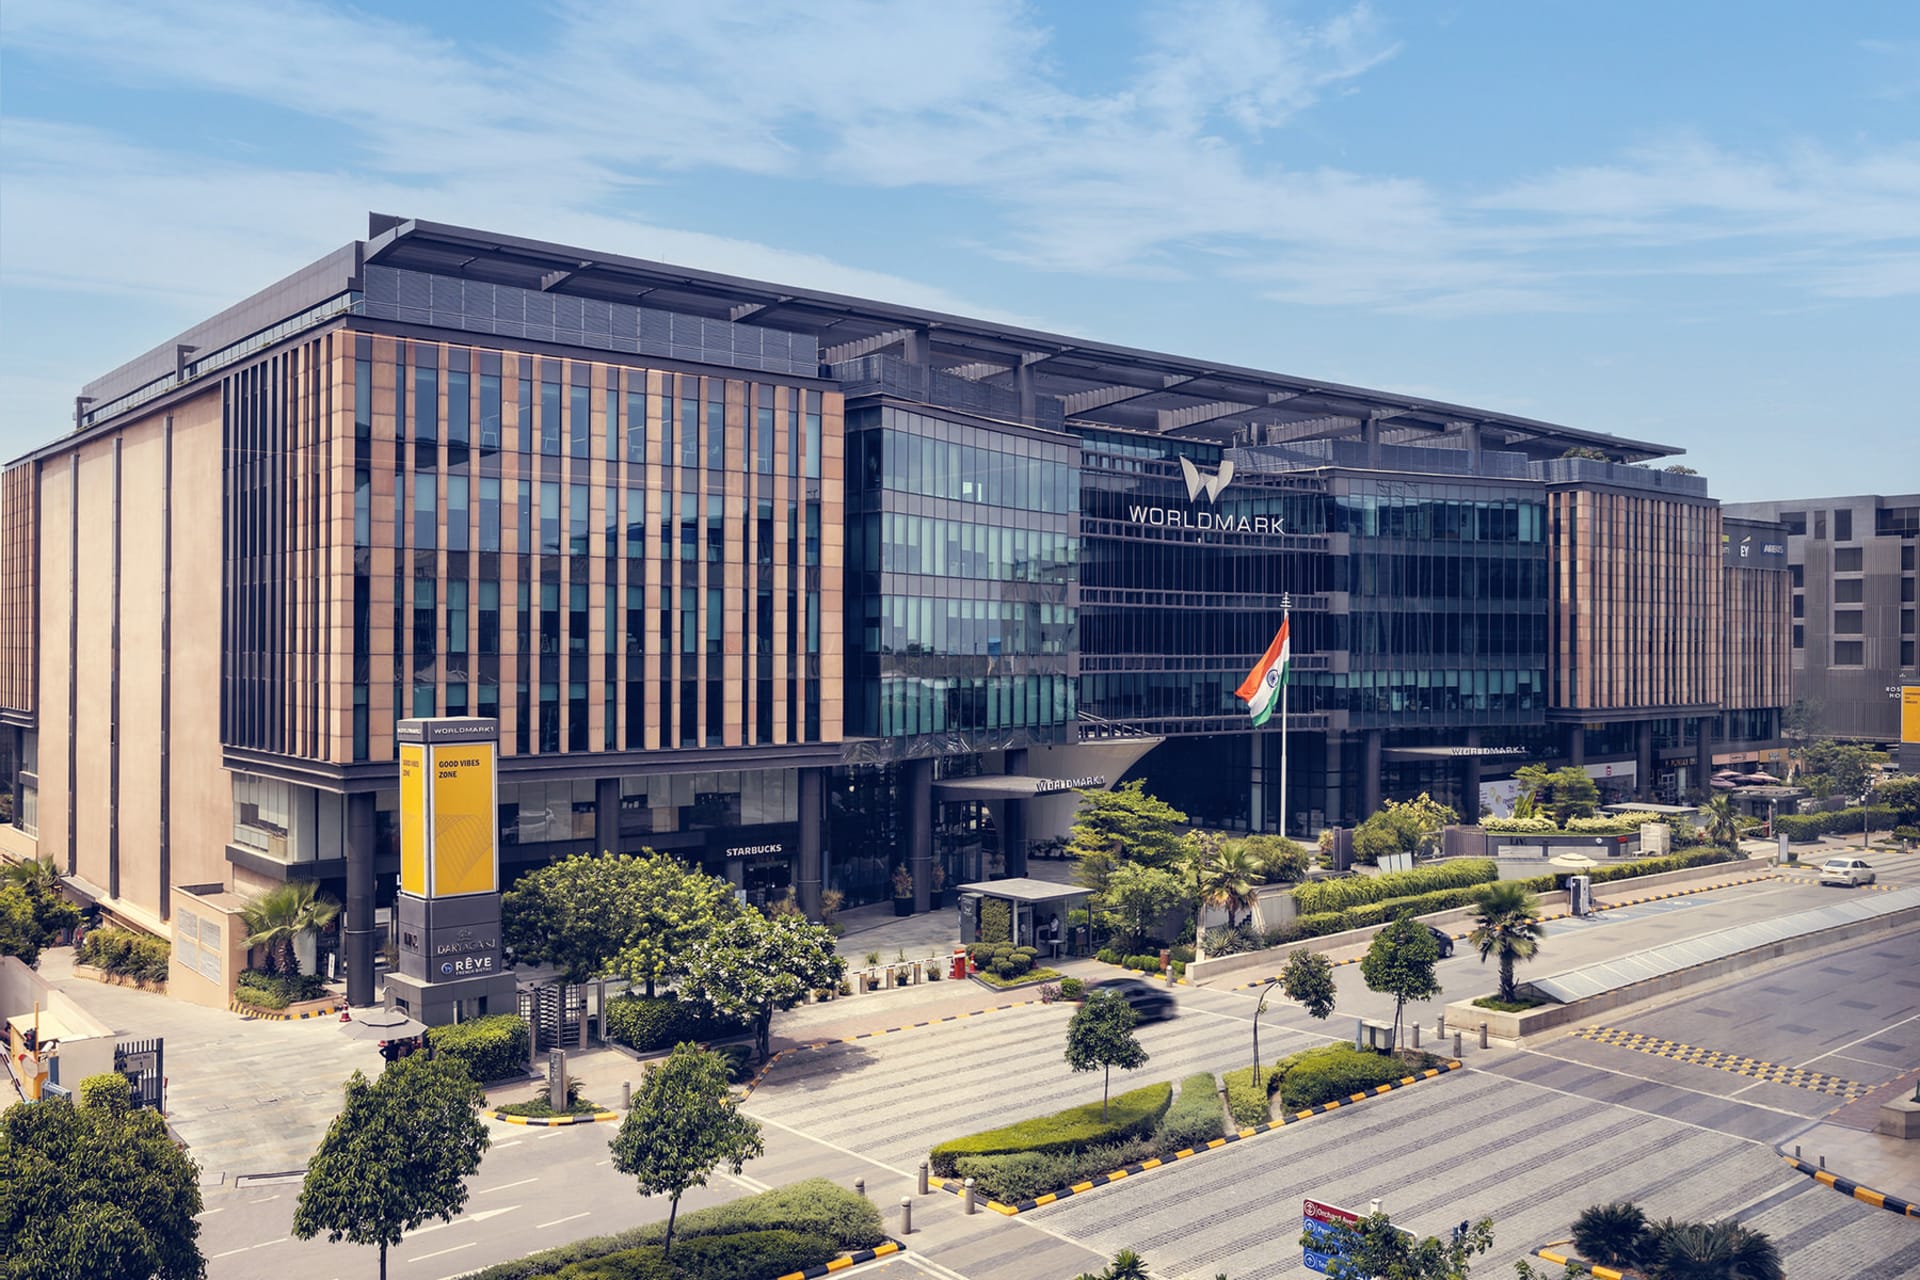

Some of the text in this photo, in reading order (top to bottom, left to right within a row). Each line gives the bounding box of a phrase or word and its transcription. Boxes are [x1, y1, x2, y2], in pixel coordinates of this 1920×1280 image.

[1129, 505, 1286, 535] WORLDMARK
[438, 759, 480, 769] GOOD VIBES
[438, 771, 457, 779] ZONE
[726, 844, 782, 857] STARBUCKS
[455, 956, 492, 971] RÊVE
